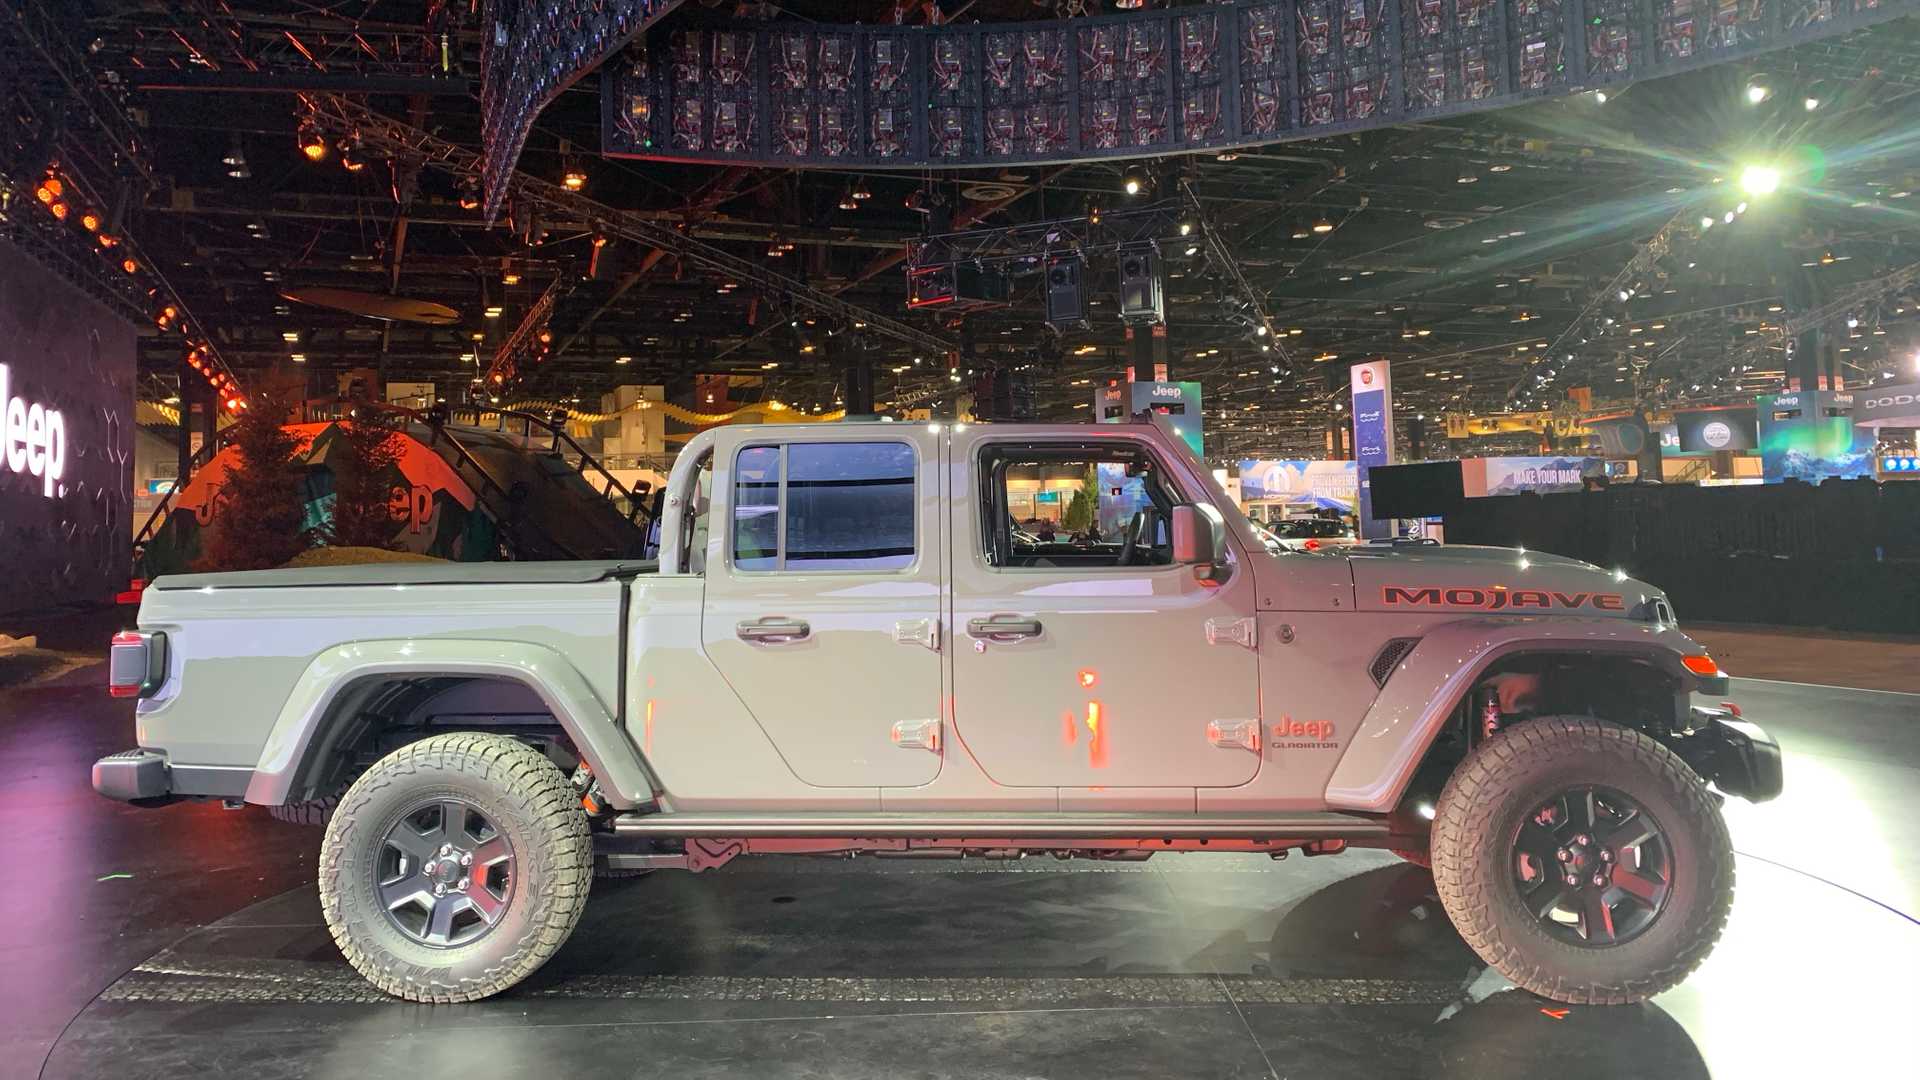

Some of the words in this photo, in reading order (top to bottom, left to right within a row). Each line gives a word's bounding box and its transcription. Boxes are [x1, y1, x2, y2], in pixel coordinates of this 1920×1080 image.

[1153, 385, 1182, 399] Jeep
[1834, 392, 1854, 403] Jeep
[1774, 396, 1799, 407] Jeep
[1660, 433, 1680, 448] Je
[1514, 470, 1536, 485] MAKE
[1537, 470, 1557, 484] YOUR
[1383, 586, 1626, 610] MOJAVE
[1271, 712, 1335, 741] Jeep
